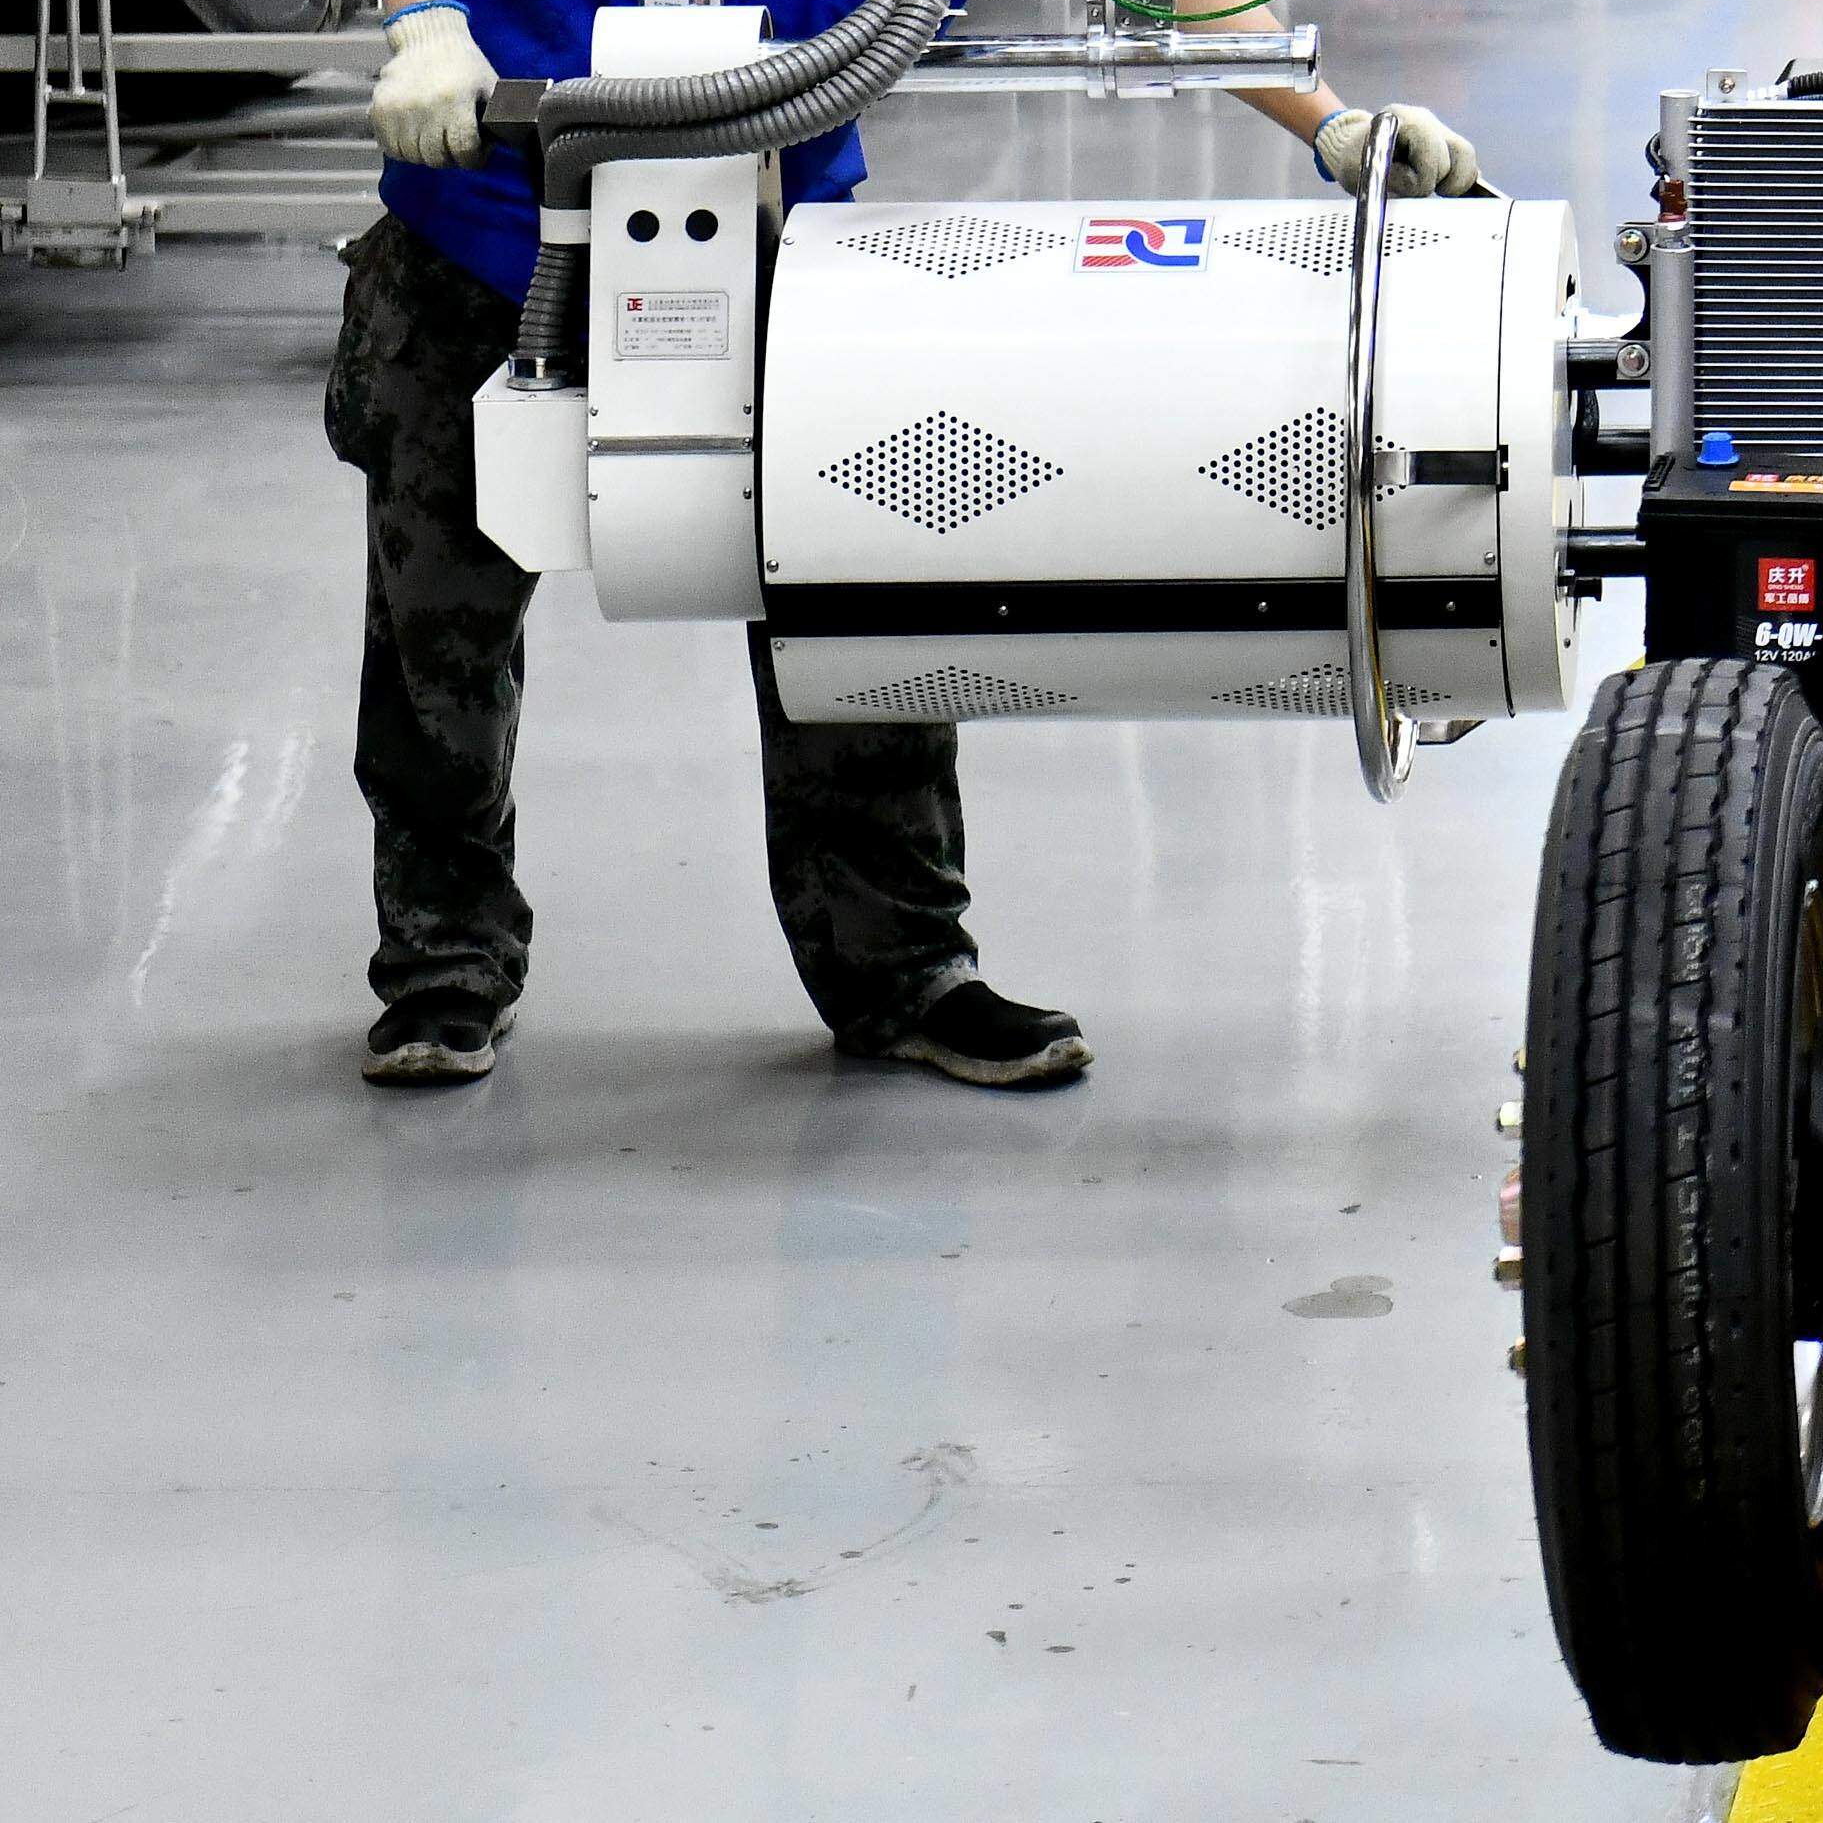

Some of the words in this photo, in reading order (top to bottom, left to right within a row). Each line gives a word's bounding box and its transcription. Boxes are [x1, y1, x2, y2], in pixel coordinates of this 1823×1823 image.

[1767, 566, 1806, 584] 庆升
[1755, 622, 1823, 649] 6-QW-
[1754, 649, 1779, 662] 12V
[1781, 650, 1816, 662] 120A
